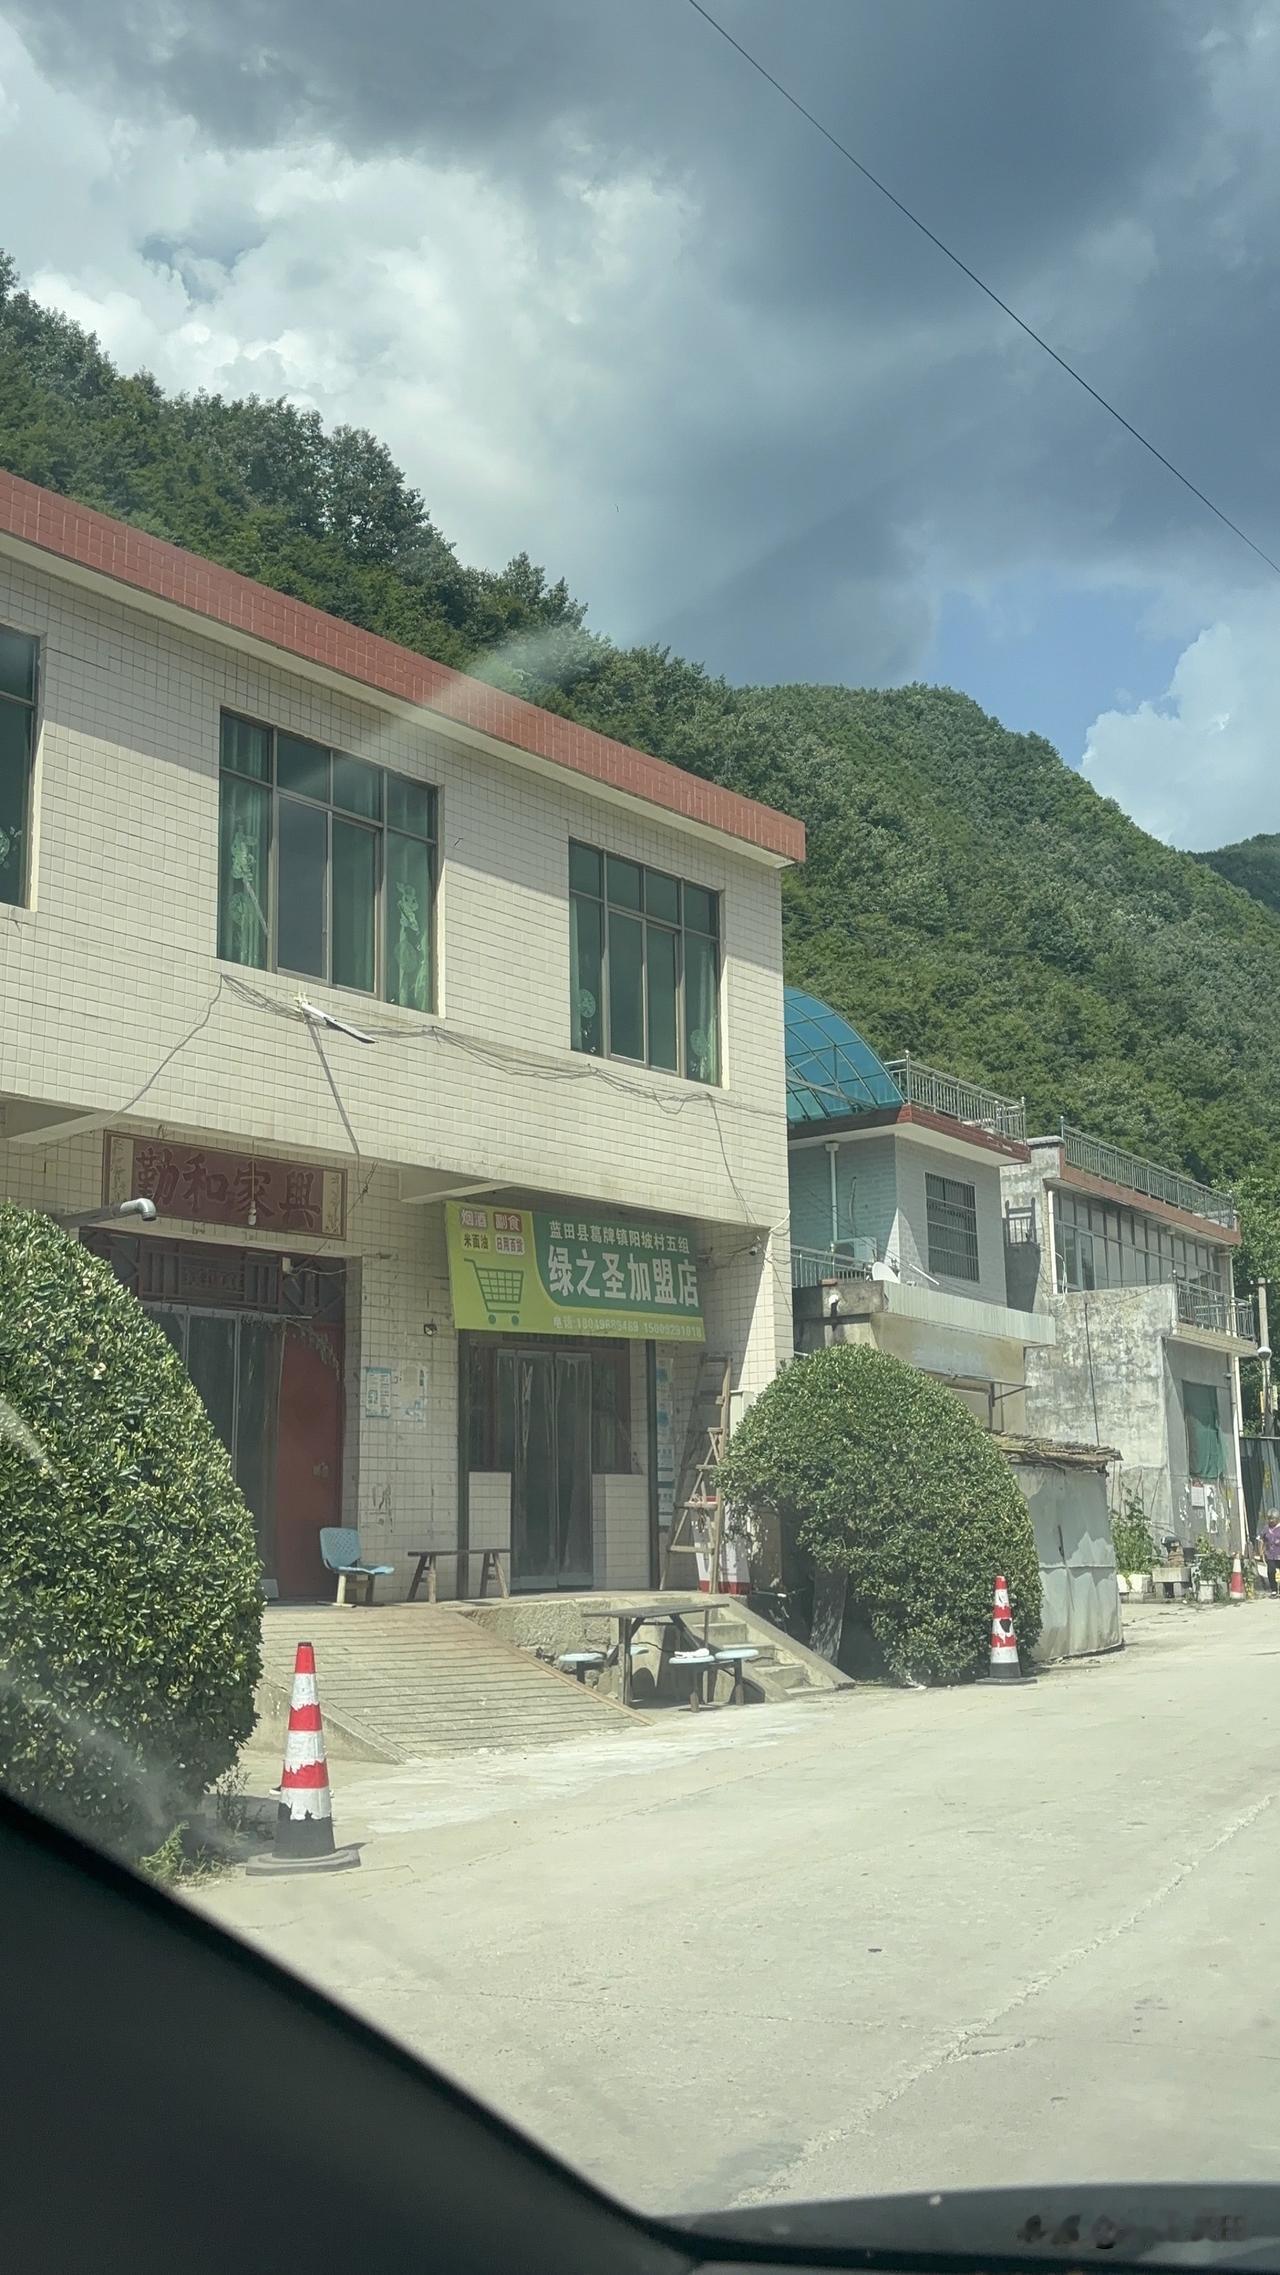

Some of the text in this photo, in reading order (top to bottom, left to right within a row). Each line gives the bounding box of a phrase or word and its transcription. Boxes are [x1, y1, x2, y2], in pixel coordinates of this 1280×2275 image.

[460, 1208, 487, 1228] 烟酒
[495, 1213, 521, 1232] 副食
[463, 1233, 489, 1250] 米面油
[496, 1236, 524, 1253] 日用百货
[549, 1219, 691, 1255] 蓝田县葛牌镇阳坡村五组
[546, 1244, 700, 1308] 绿之圣加盟店
